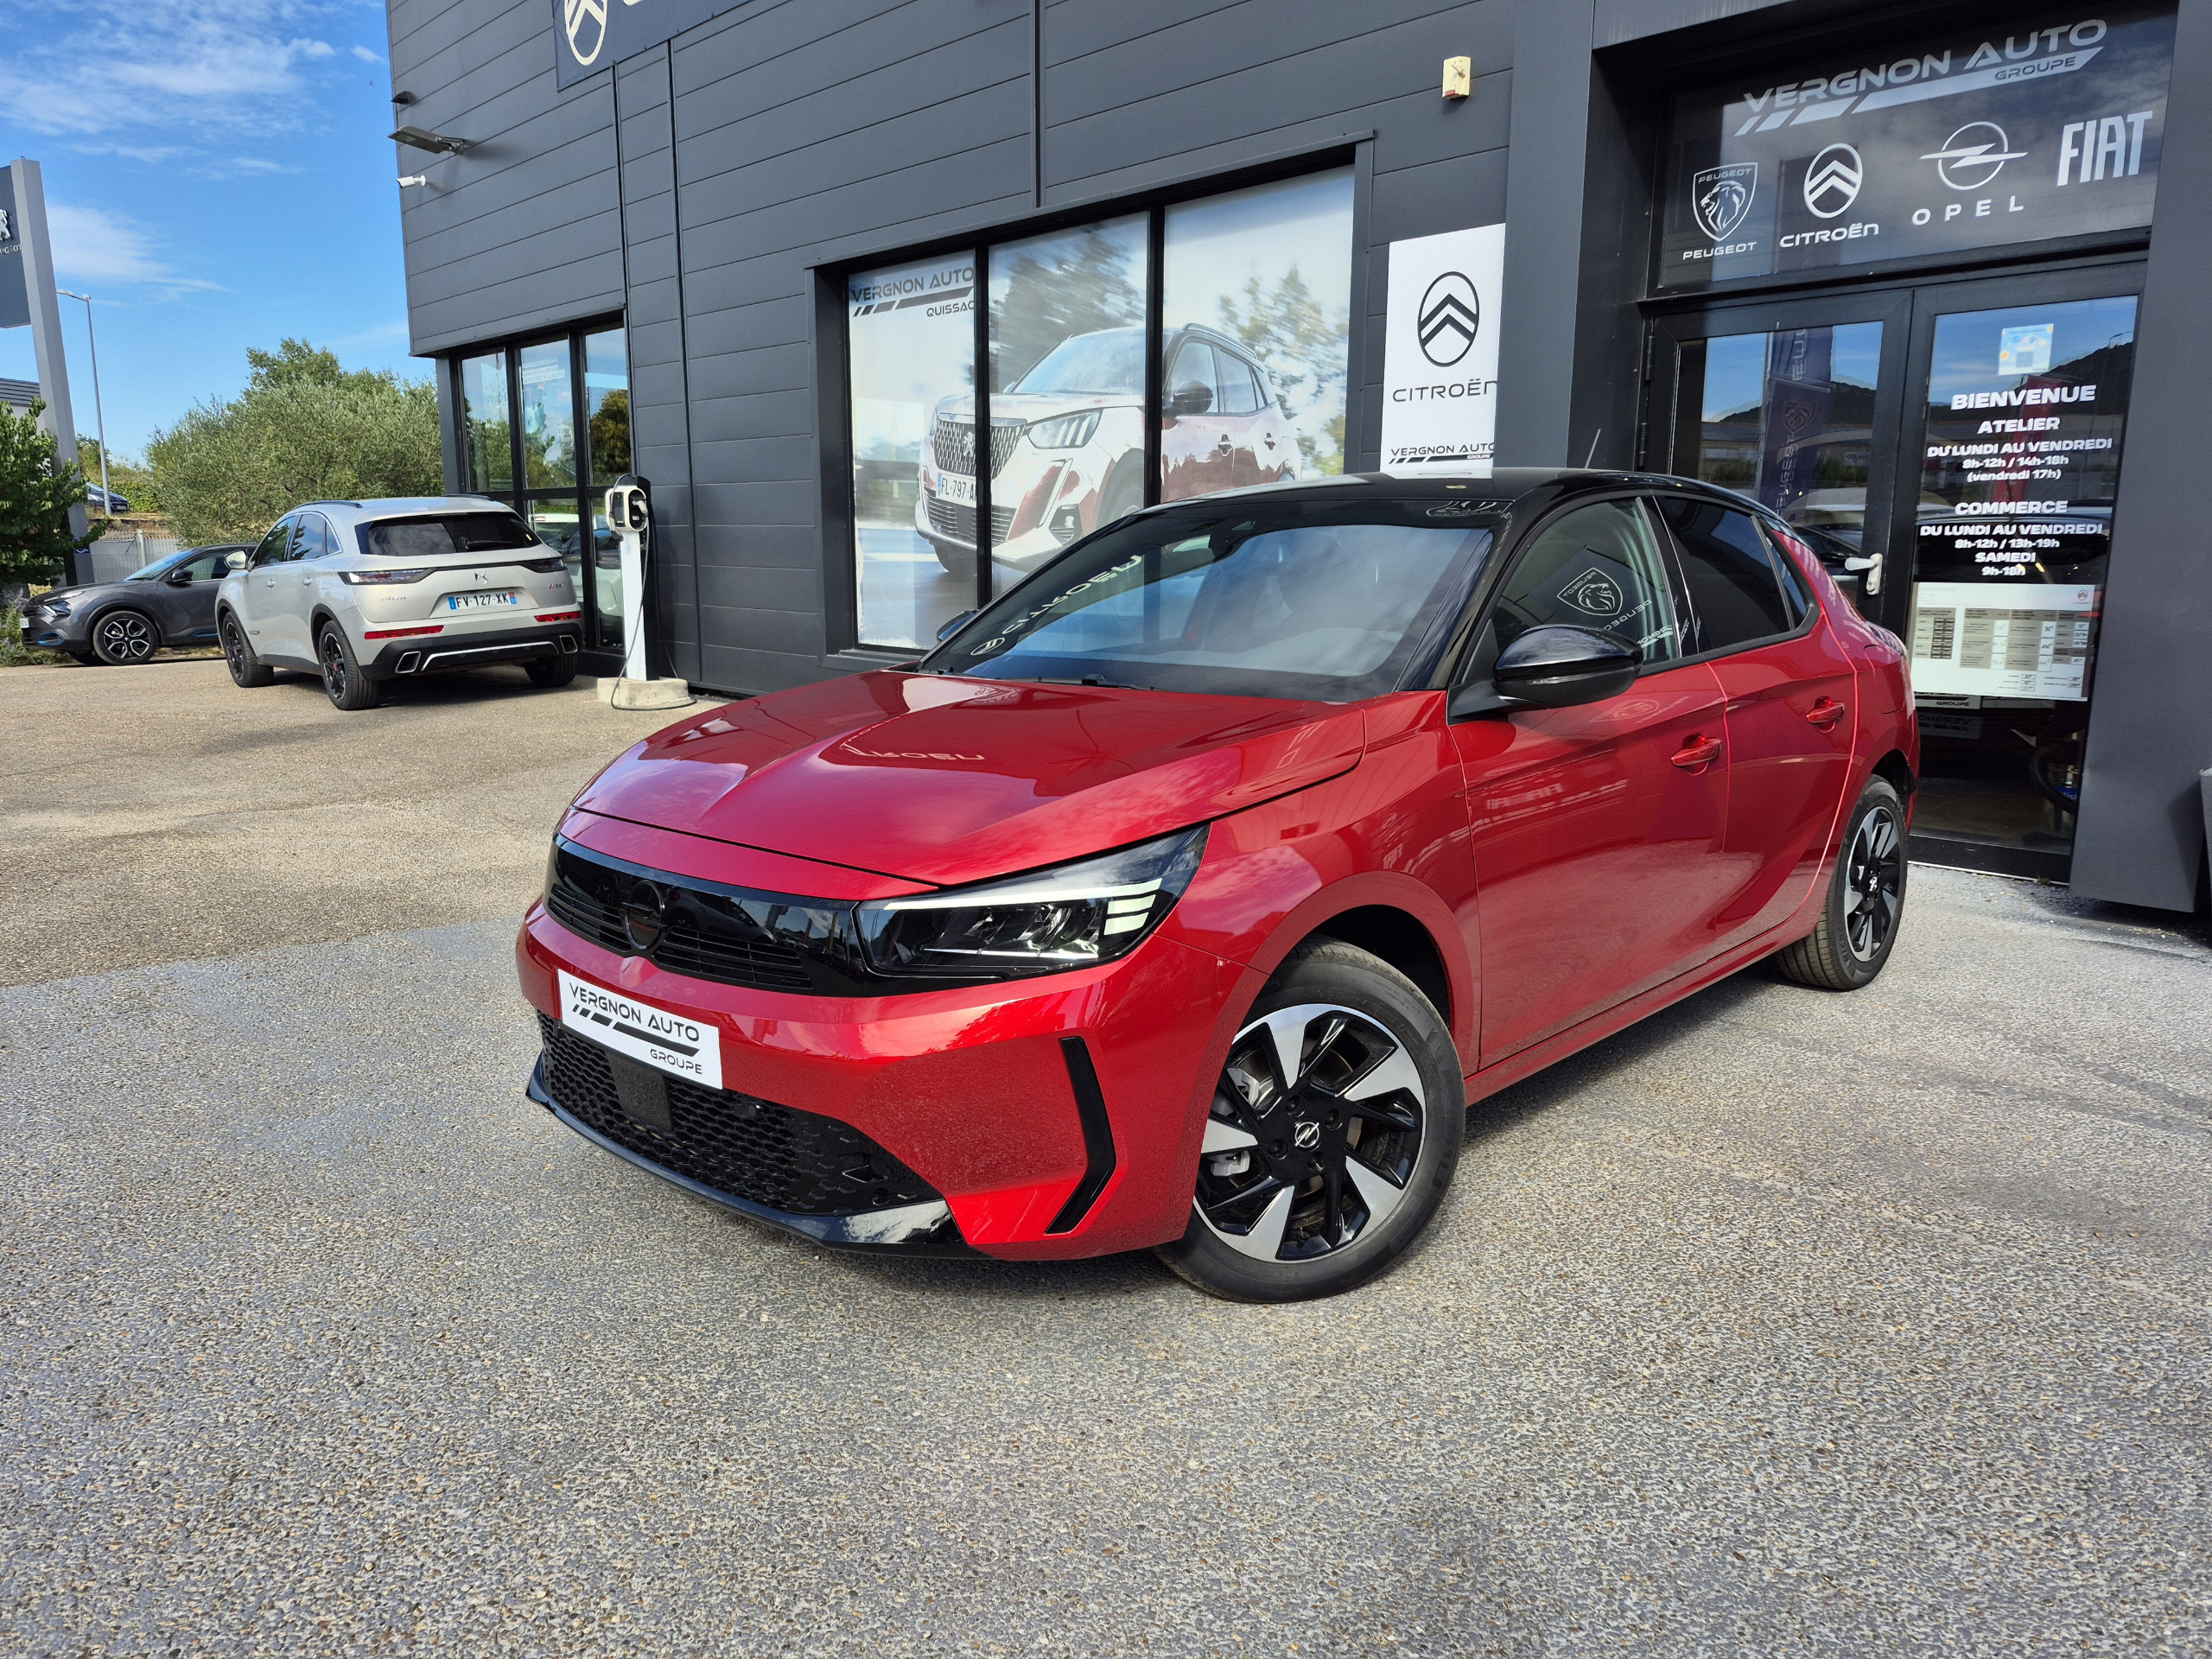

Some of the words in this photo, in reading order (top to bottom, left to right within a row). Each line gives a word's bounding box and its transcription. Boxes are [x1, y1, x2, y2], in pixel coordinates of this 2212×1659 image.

[1743, 50, 1951, 113] VERGNON
[1964, 18, 2107, 70] AUTO
[1994, 56, 2076, 80] GROUPE
[2056, 111, 2153, 187] FIAT
[1698, 168, 1752, 184] PEUGEOT
[1911, 195, 2024, 226] OPEL
[1682, 241, 1758, 261] PEUGEOT
[851, 276, 925, 302] VERGNON
[929, 266, 975, 289] AUTO
[1950, 385, 2097, 410] BIENVENUE
[1977, 416, 2061, 435] ATELIER
[1390, 445, 1455, 456] VERGNON
[1927, 446, 1950, 457] DU
[1951, 444, 1999, 456] LUNDI
[2000, 442, 2025, 454] AU
[2027, 437, 2113, 452] VENDREDI
[1962, 457, 2006, 469] 8h-12h
[2018, 455, 2069, 467] 14h-18h
[1967, 470, 2031, 483] (vendredi
[2031, 468, 2062, 480] 17h)
[941, 477, 976, 502] FL-797-A
[1955, 500, 2069, 515] COMMERCE
[1920, 524, 1942, 536] DU
[1944, 524, 1990, 536] LUNDI
[1992, 524, 2017, 536] AU
[2018, 523, 2102, 535] VENDREDI
[1955, 539, 1998, 549] 8h-12h
[2008, 538, 2060, 549] 13h-19h
[1974, 552, 2036, 563] SAMEDI
[1981, 566, 2026, 576] 9h-18h
[455, 593, 509, 607] FV-127-XK
[569, 982, 642, 1024] VERGNON
[647, 1014, 700, 1042] AUTO
[650, 1048, 702, 1075] GROUPE
